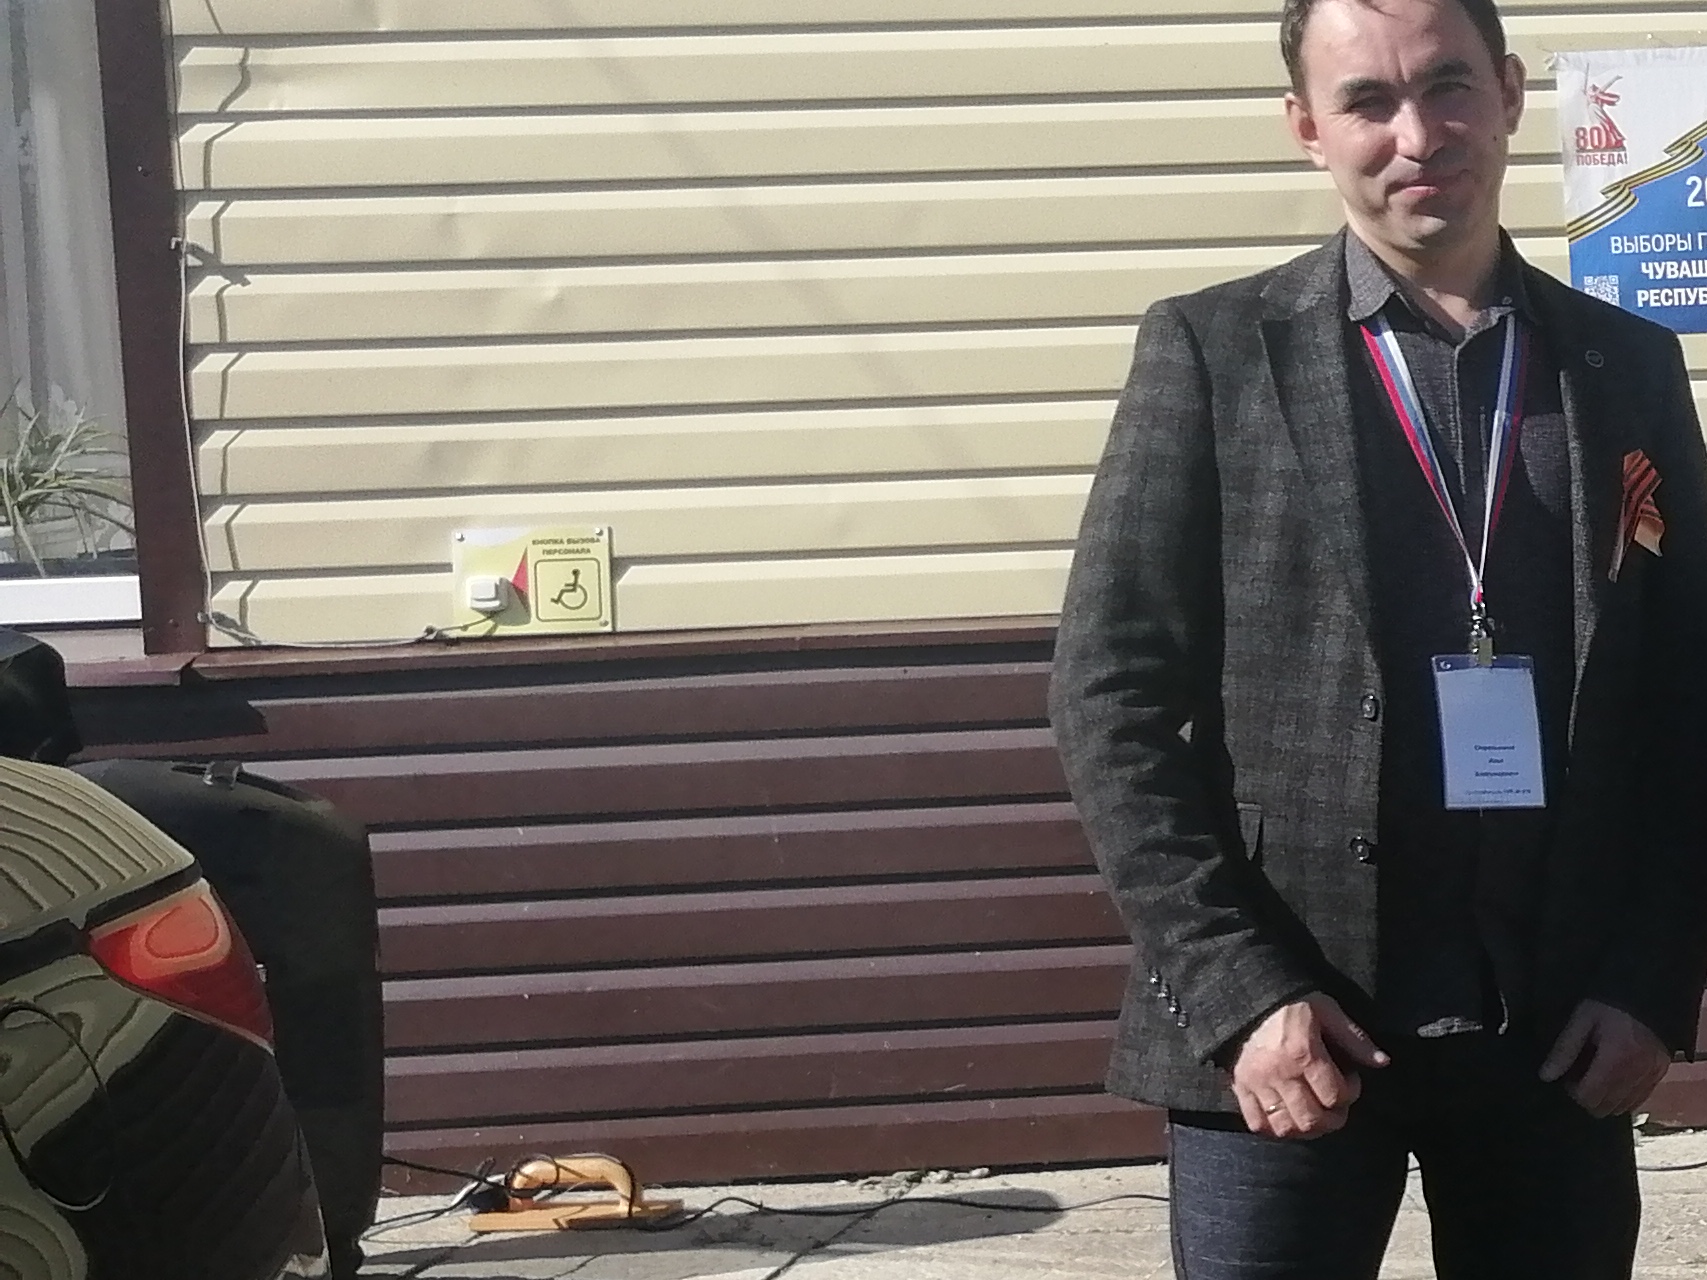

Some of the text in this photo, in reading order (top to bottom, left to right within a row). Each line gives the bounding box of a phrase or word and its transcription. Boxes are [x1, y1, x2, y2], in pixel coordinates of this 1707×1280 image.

[1575, 126, 1606, 150] 80
[1576, 152, 1628, 167] ПОБЕДА!
[1610, 232, 1692, 254] ВЫБОРЫ
[542, 548, 591, 556] ПЕРСОНАЛА
